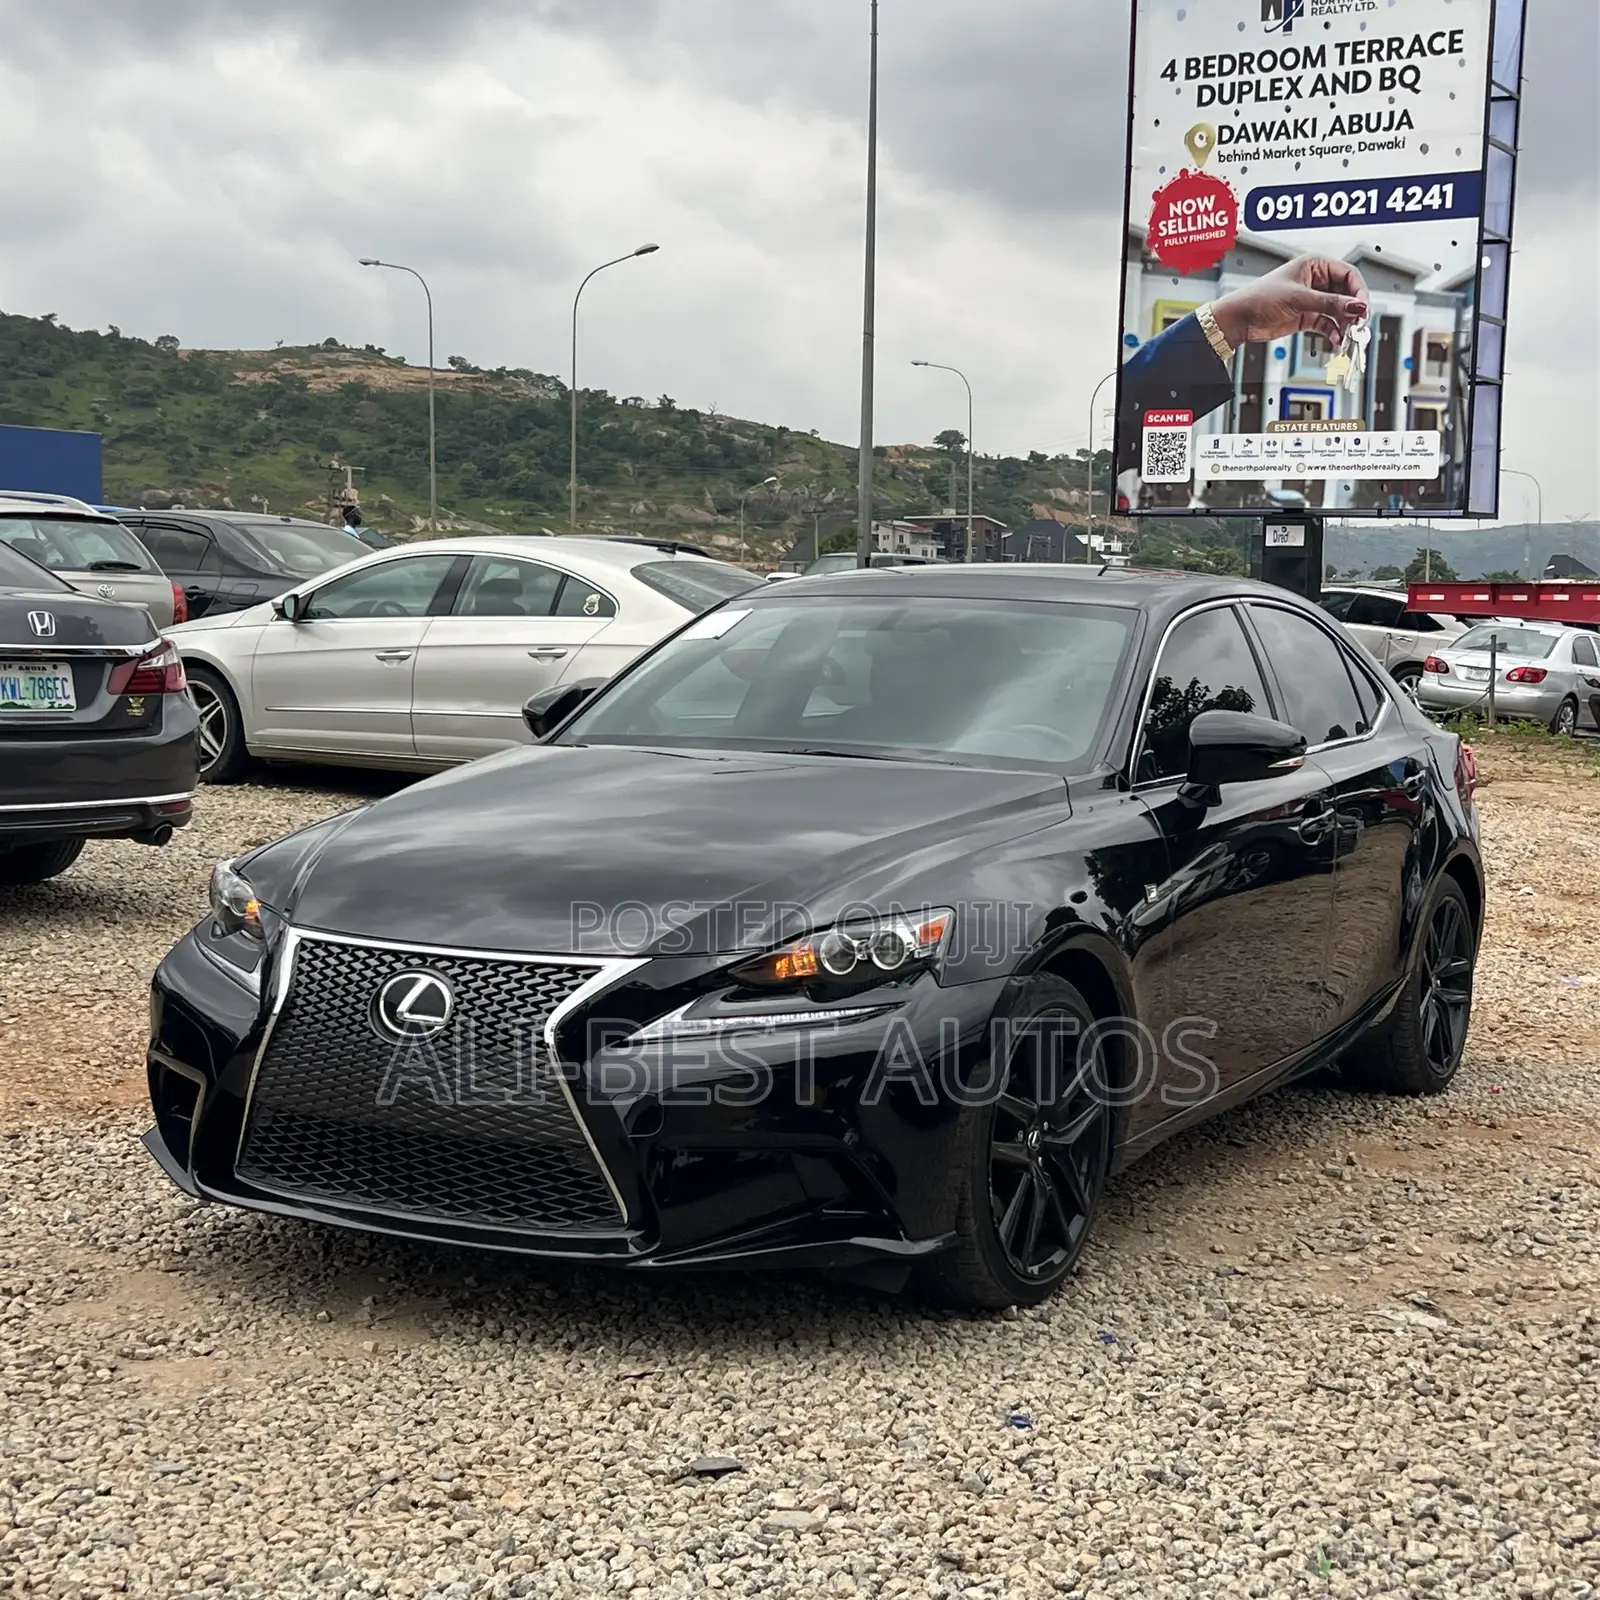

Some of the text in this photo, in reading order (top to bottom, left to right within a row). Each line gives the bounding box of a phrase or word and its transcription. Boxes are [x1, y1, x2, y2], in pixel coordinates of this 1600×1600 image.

[1310, 4, 1352, 16] REALTY
[1160, 29, 1464, 82] 4 BEDROOM TERRACE
[1197, 64, 1421, 108] DUPLEX AND BQ
[1217, 117, 1317, 145] DAWAKI
[1218, 136, 1406, 163] behind Market Square, Dawaki
[1169, 195, 1216, 218] NOW
[1256, 183, 1454, 221] 091 2021 4241
[1158, 210, 1229, 237] SELLING
[1164, 230, 1226, 247] FULLY FINISHED
[1148, 414, 1189, 423] SCAN ME
[1274, 422, 1358, 432] ESTATE FEATURES
[1222, 464, 1292, 473] thenorthpolerealty
[1307, 462, 1420, 472] www.thenorthpolerealty.com
